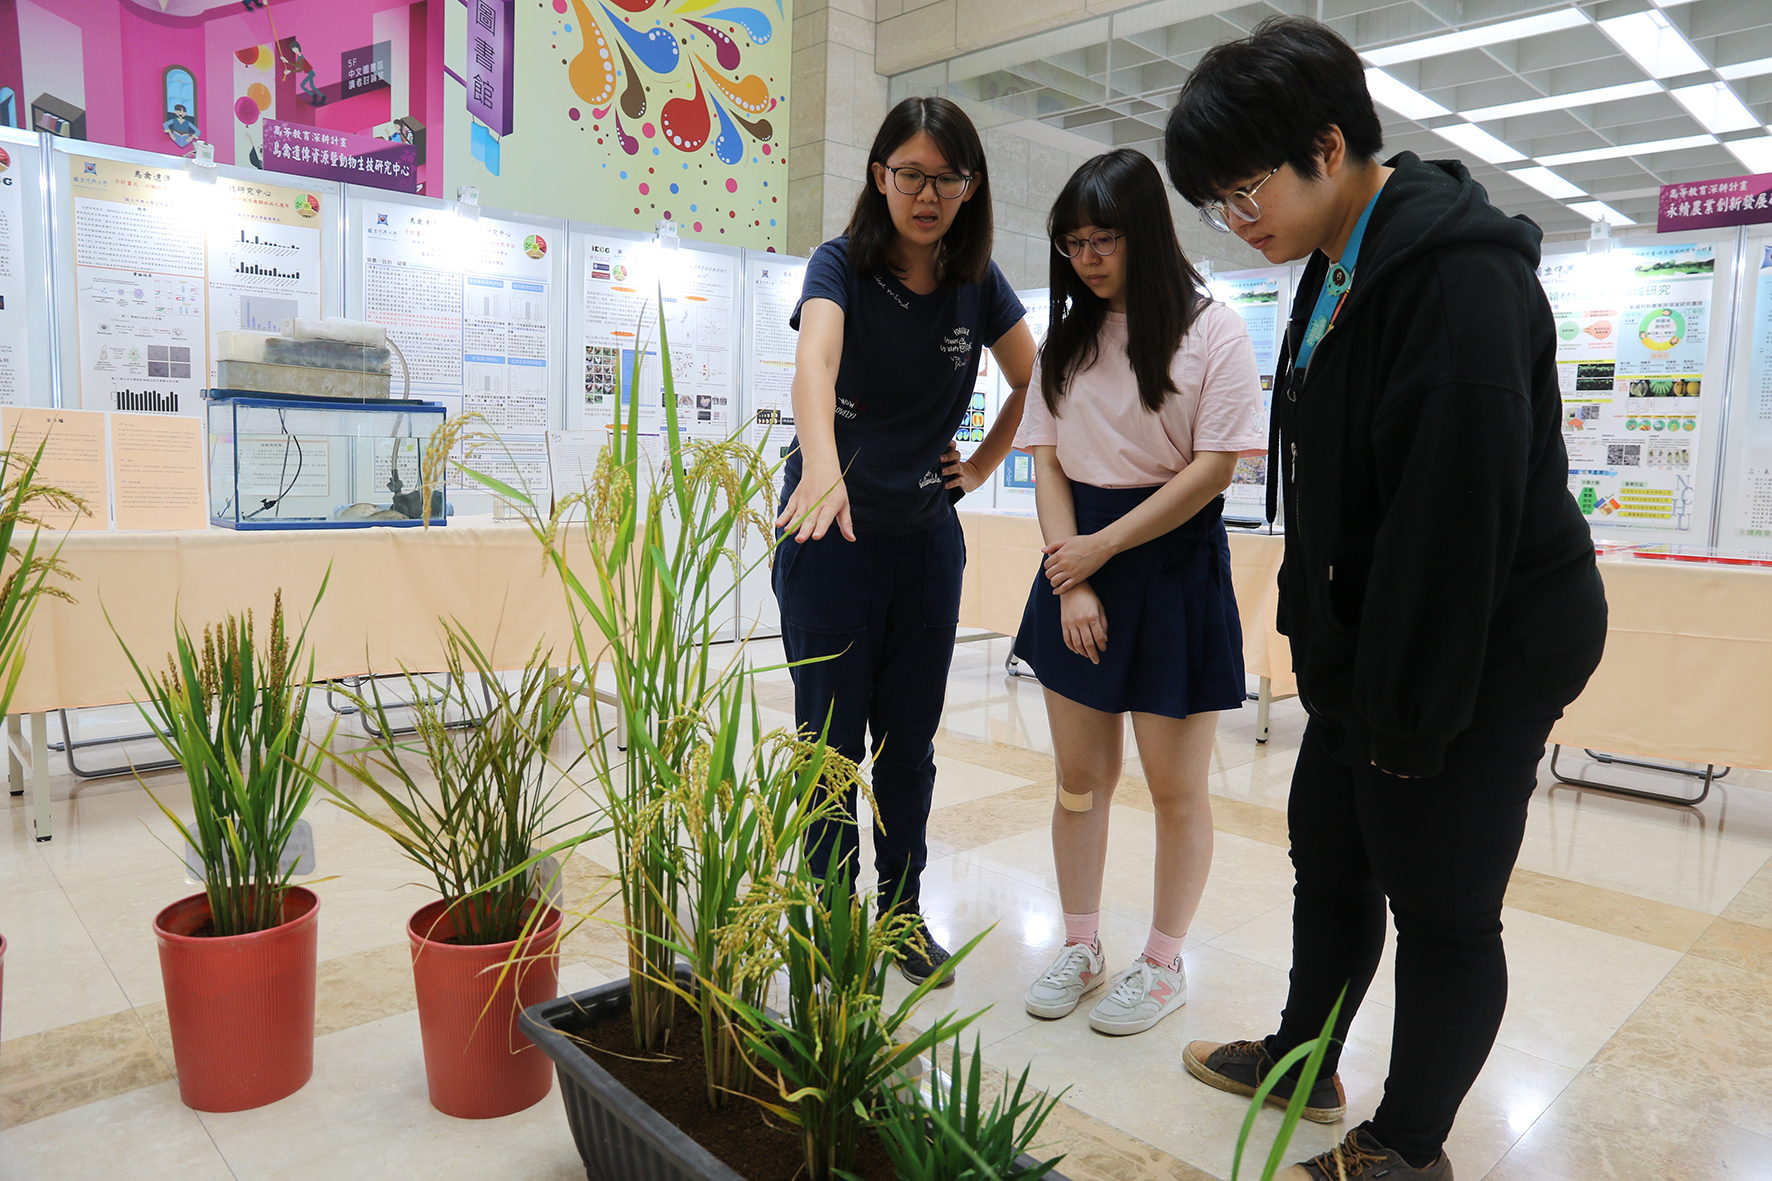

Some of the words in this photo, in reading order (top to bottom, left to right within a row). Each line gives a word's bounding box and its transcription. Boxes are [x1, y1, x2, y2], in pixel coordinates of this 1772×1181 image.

[347, 57, 357, 67] 5F
[473, 0, 497, 110] 圖書館
[273, 125, 348, 148] 高等教育深耕計畫
[272, 140, 411, 177] 鳥禽遺傳資源暨動物生技研究中心
[1669, 180, 1748, 199] 高等教育深耕計畫
[1666, 192, 1772, 219] 永續農業創新發展
